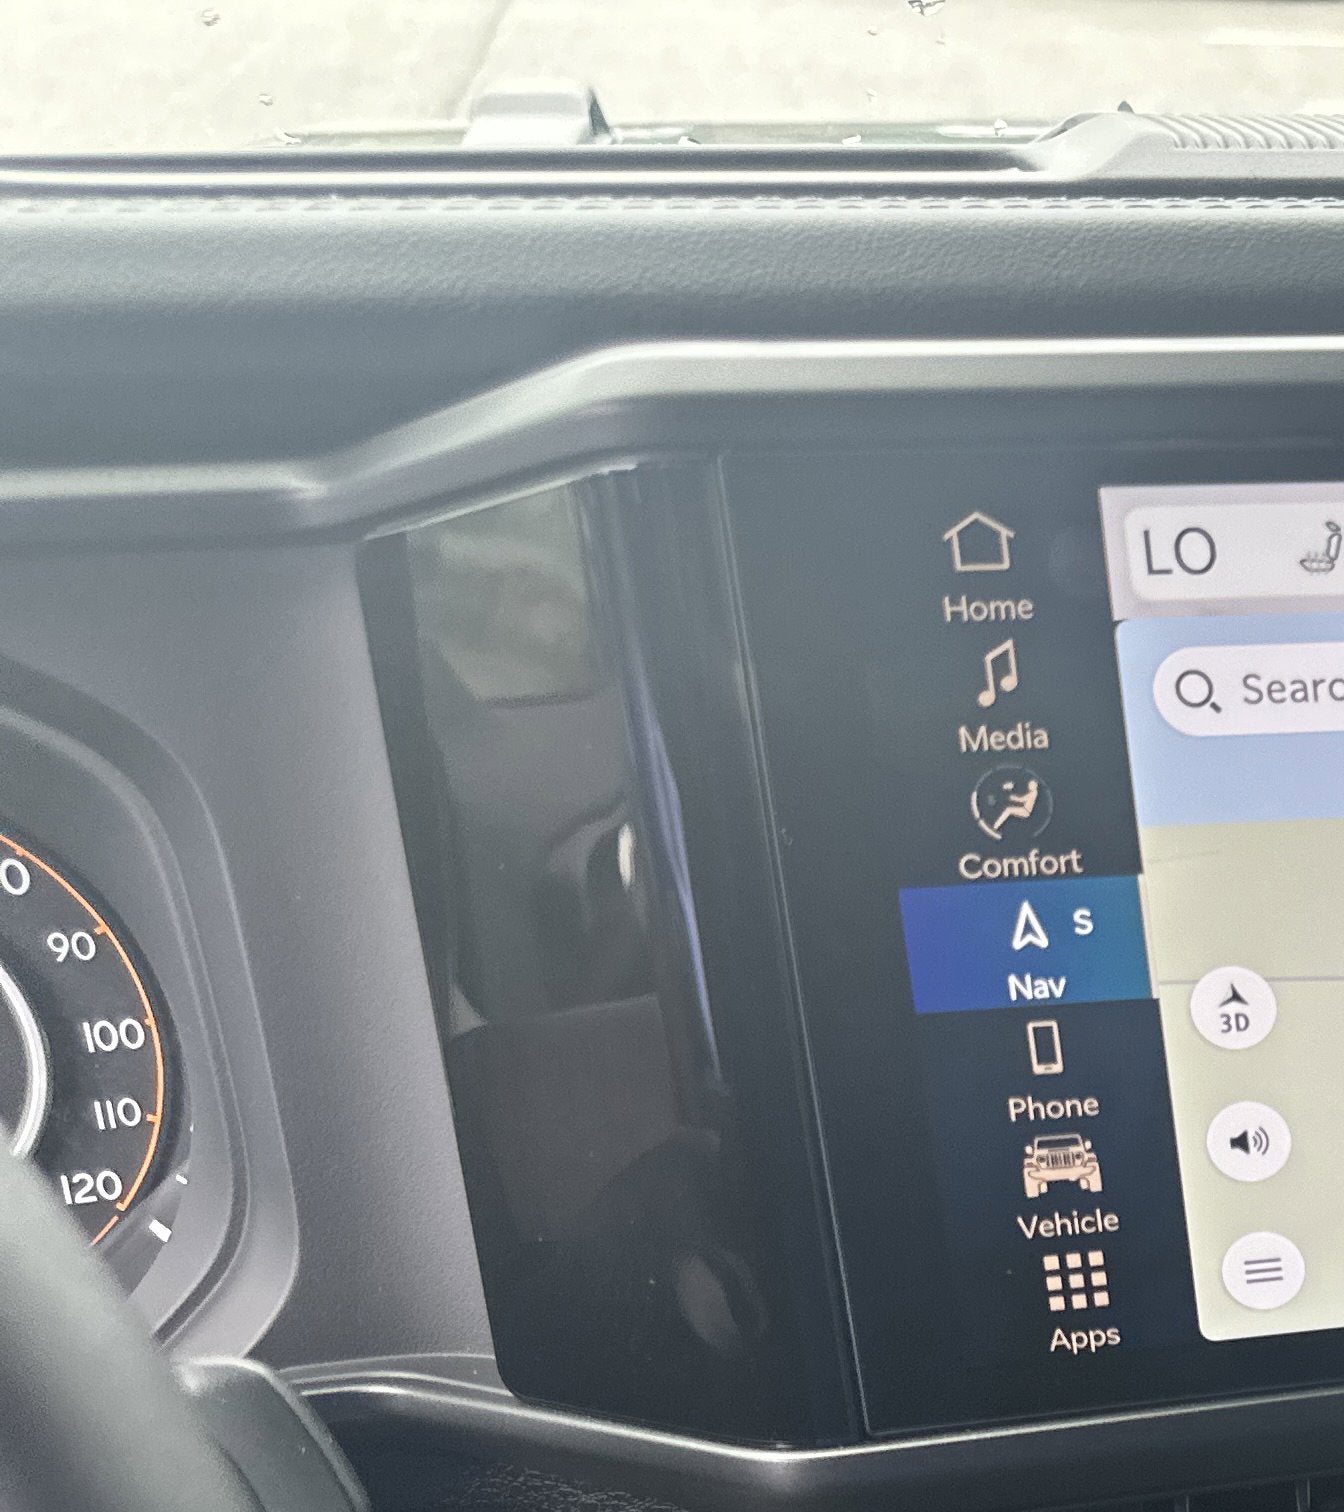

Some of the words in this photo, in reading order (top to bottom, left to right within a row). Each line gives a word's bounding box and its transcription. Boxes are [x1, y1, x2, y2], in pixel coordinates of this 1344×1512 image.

[1143, 527, 1217, 577] LO
[944, 596, 1034, 622] Home
[958, 724, 1050, 753] Media
[958, 849, 1084, 880] Comfort
[1072, 909, 1094, 937] S
[47, 931, 96, 963] 90
[1008, 974, 1067, 1002] Nav
[83, 1017, 146, 1055] 100
[1219, 1013, 1250, 1035] 3D
[94, 1097, 142, 1132] 110
[1008, 1096, 1100, 1122] Phone
[60, 1169, 124, 1205] 120
[1017, 1208, 1120, 1240] Vehicle
[1050, 1325, 1121, 1355] Apps
